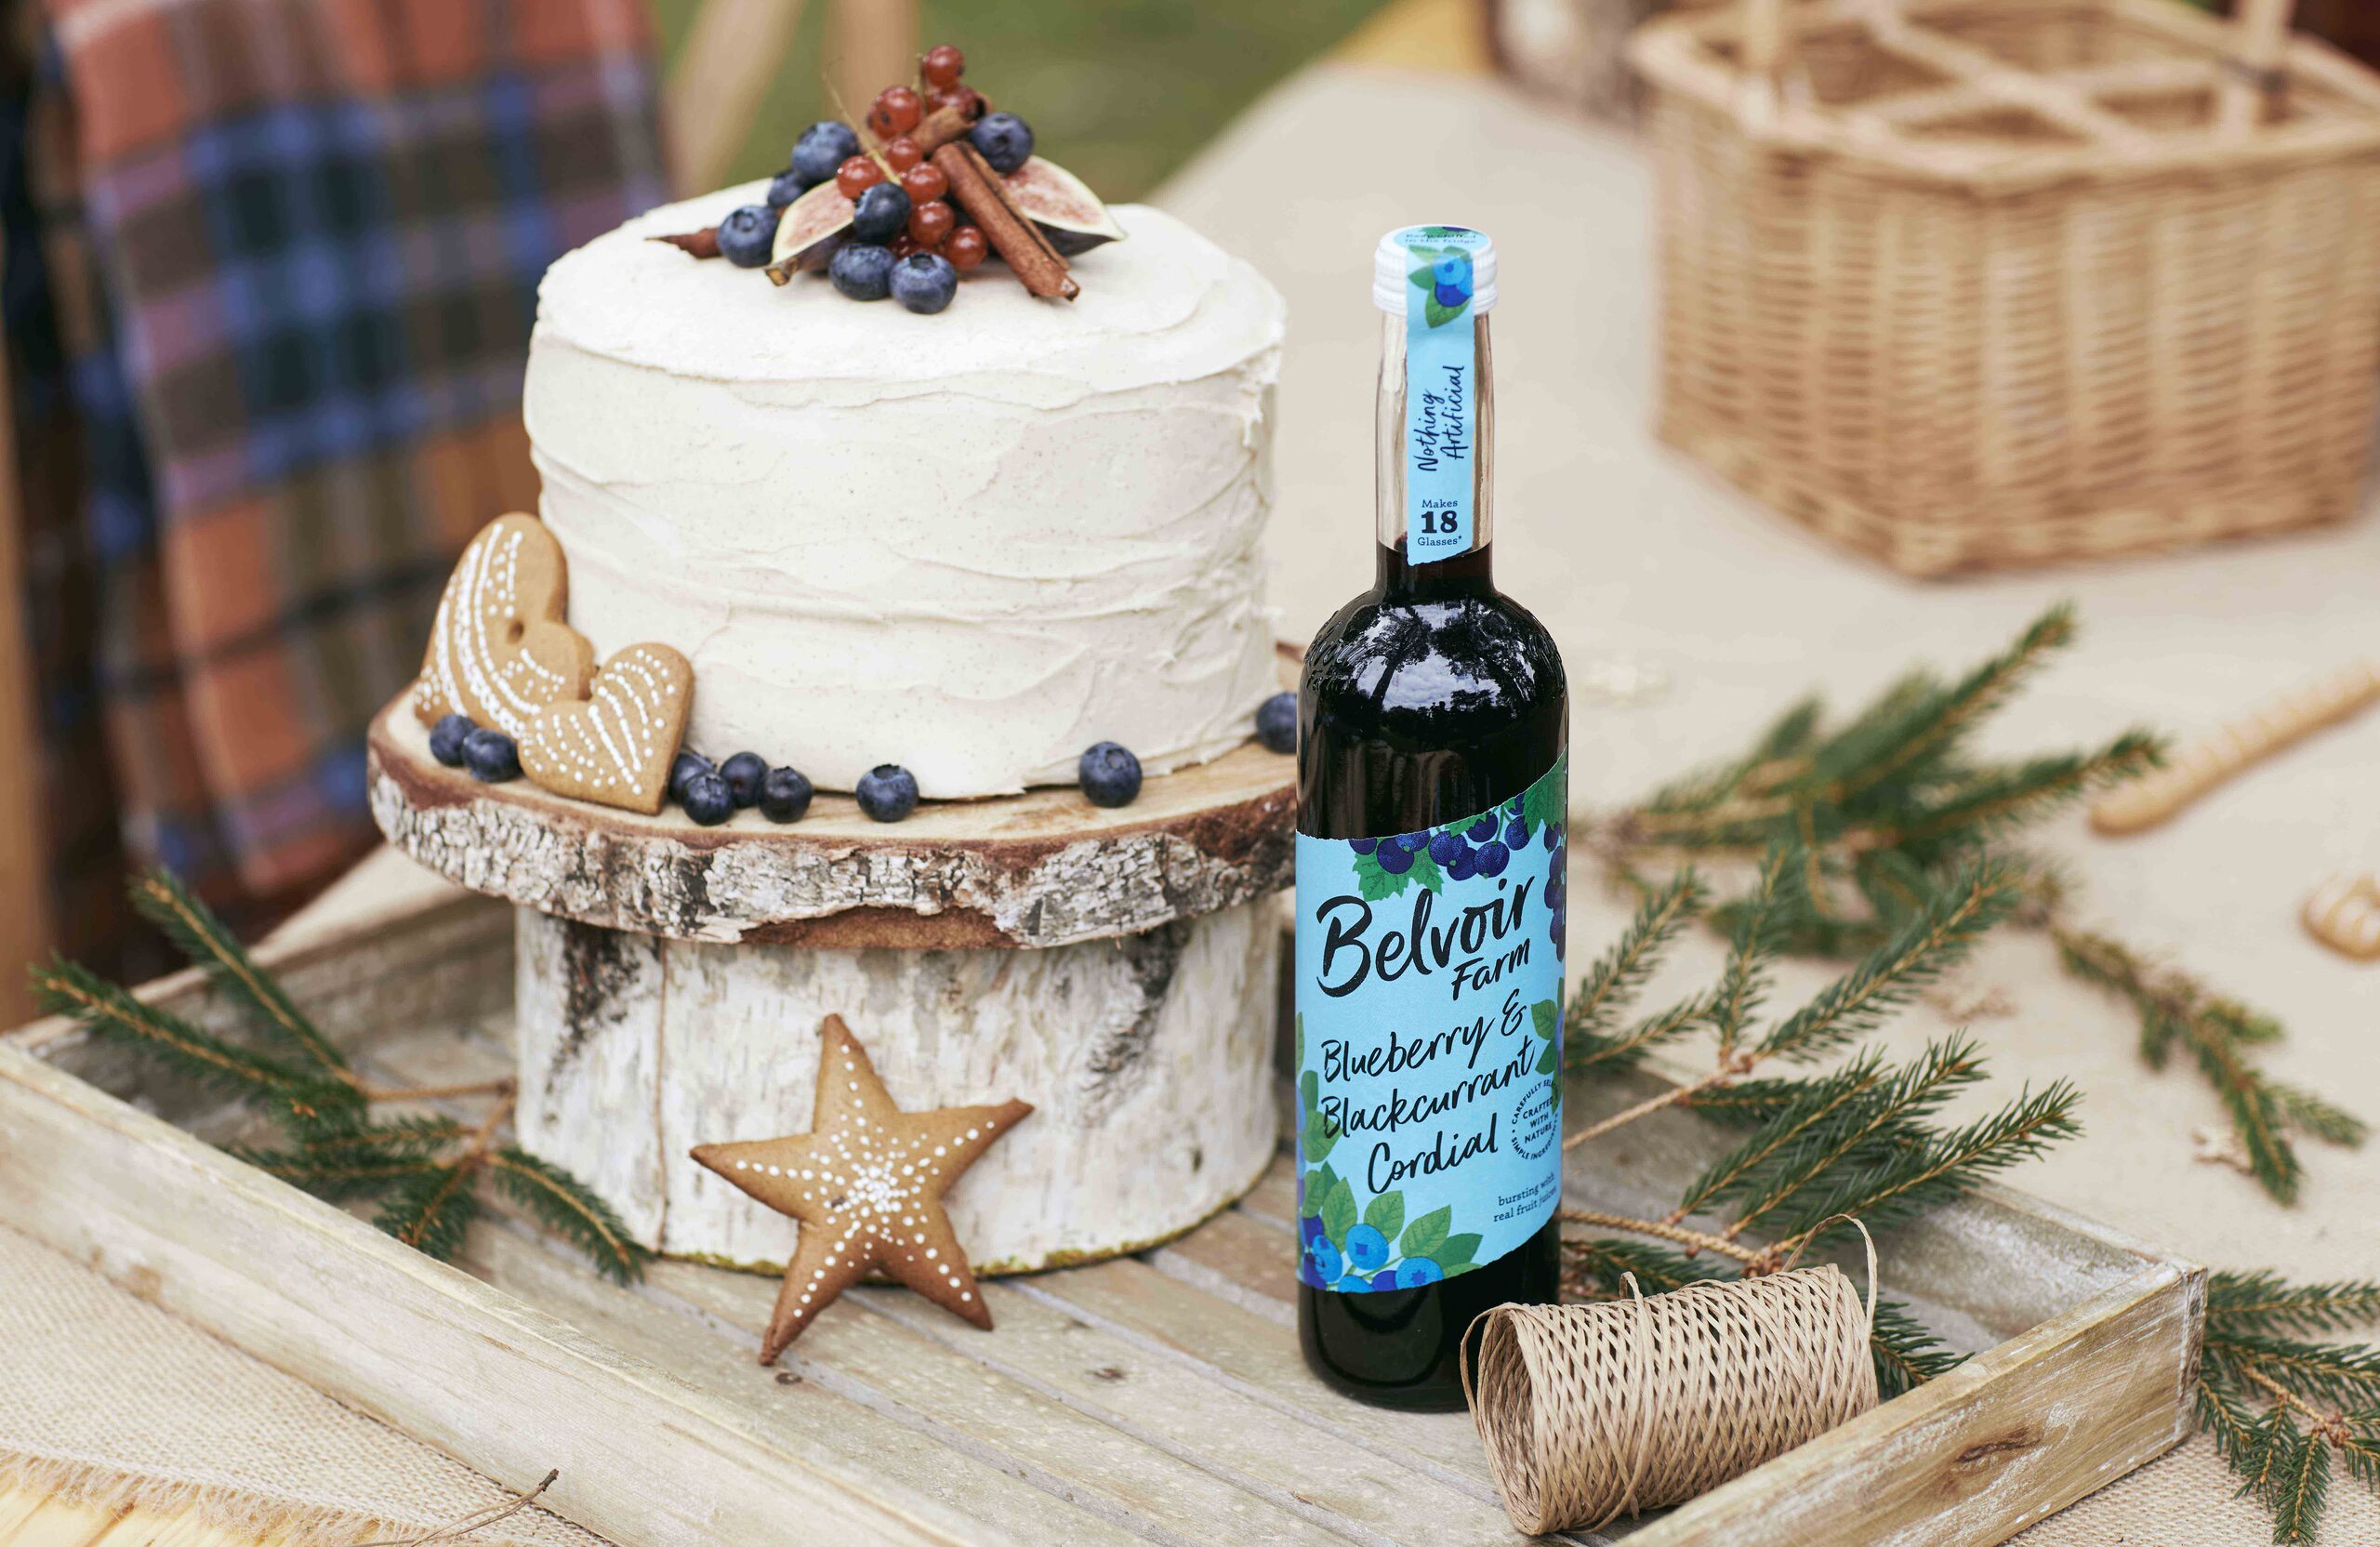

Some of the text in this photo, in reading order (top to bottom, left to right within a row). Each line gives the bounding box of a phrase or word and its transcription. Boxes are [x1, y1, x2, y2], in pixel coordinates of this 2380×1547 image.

[1413, 388, 1445, 471] Nothing
[1440, 365, 1469, 460] Artificial
[1421, 499, 1458, 509] Makes
[1421, 510, 1458, 534] 18
[1316, 876, 1535, 998] Belvoir
[1451, 938, 1530, 1000] Farm
[1321, 988, 1527, 1083] Blueberry &
[1321, 1035, 1536, 1139] Blackcurrant
[1524, 1121, 1553, 1144] NATURE
[1529, 1112, 1549, 1128] WITH
[1368, 1112, 1499, 1195] Cordial
[1511, 1136, 1530, 1160] SIMPLE
[1493, 1208, 1514, 1223] real
[1516, 1200, 1537, 1215] fruit
[1498, 1184, 1539, 1206] bursting
